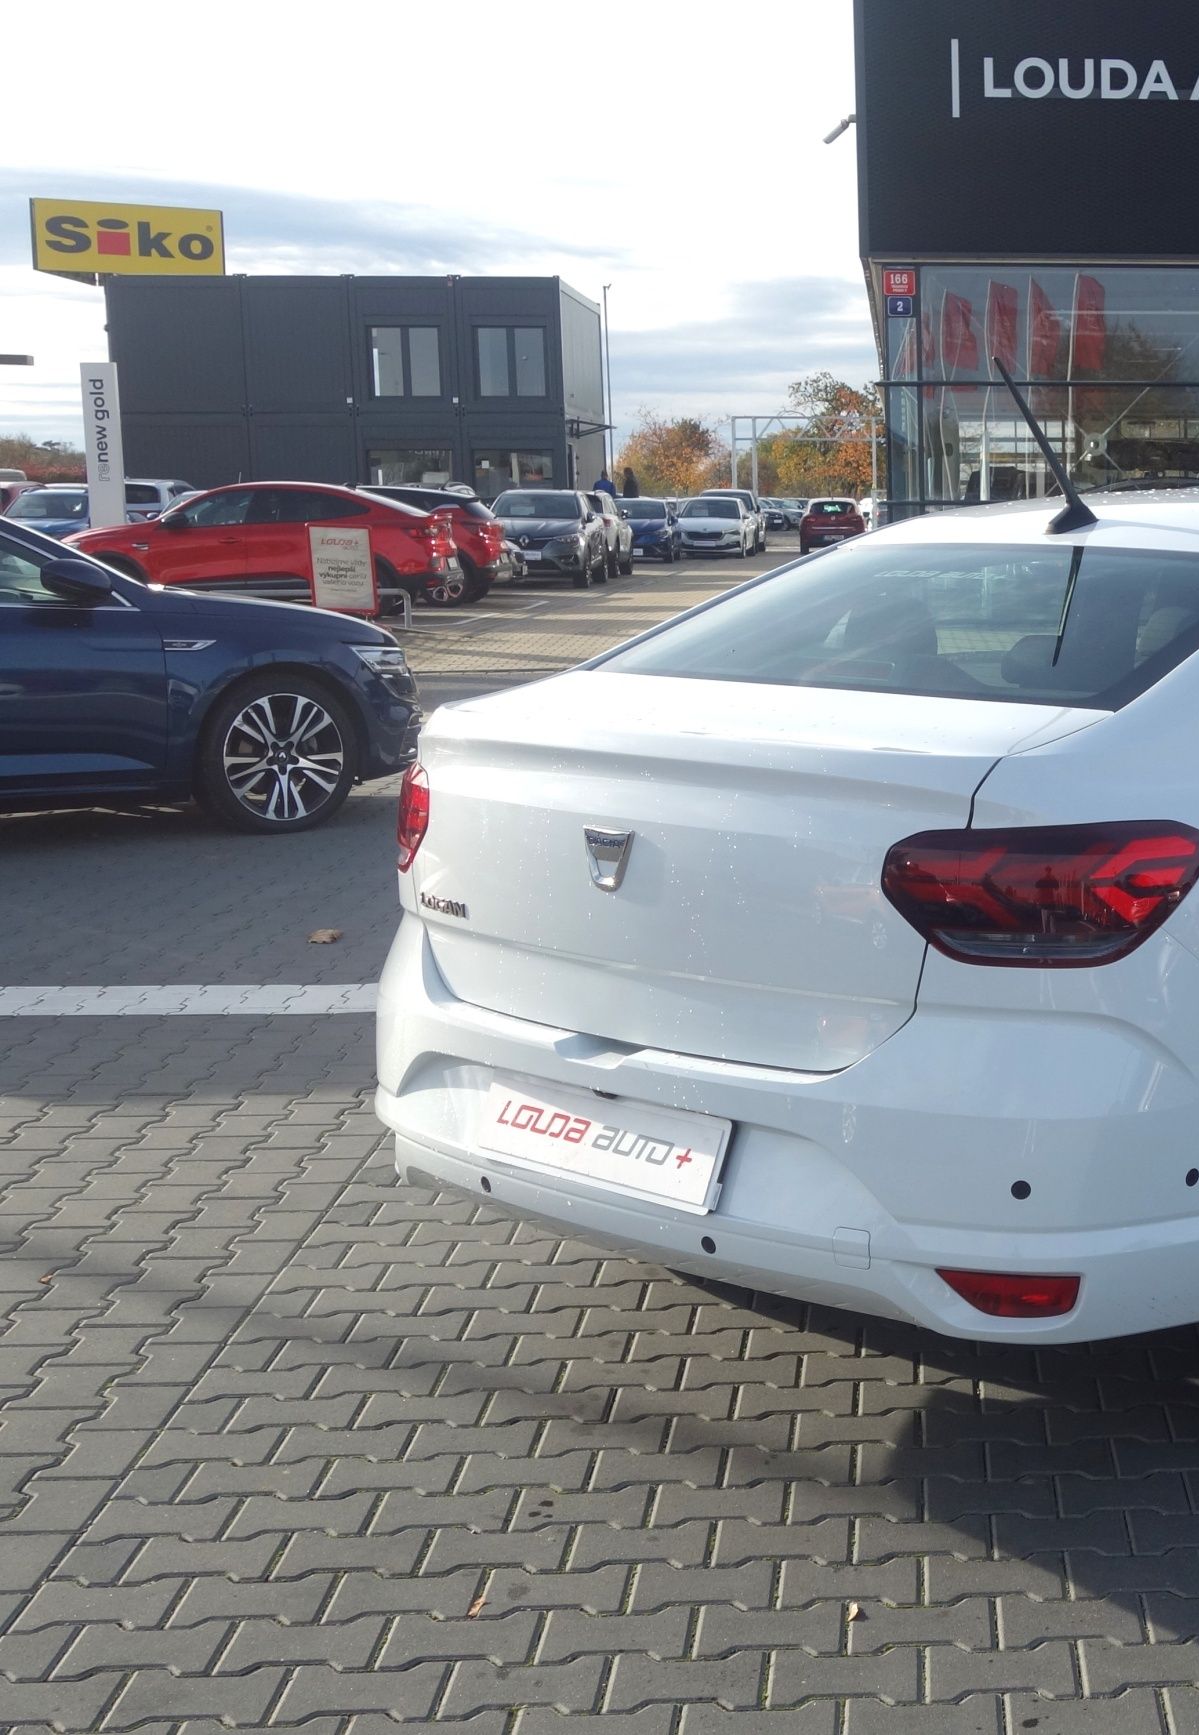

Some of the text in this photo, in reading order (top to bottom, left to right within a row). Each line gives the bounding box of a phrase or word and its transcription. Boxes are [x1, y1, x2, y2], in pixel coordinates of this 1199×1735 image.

[983, 57, 1180, 101] LOUDA
[45, 215, 214, 261] Siko
[890, 273, 908, 284] 166
[896, 301, 904, 312] 2
[88, 378, 111, 482] renew gold
